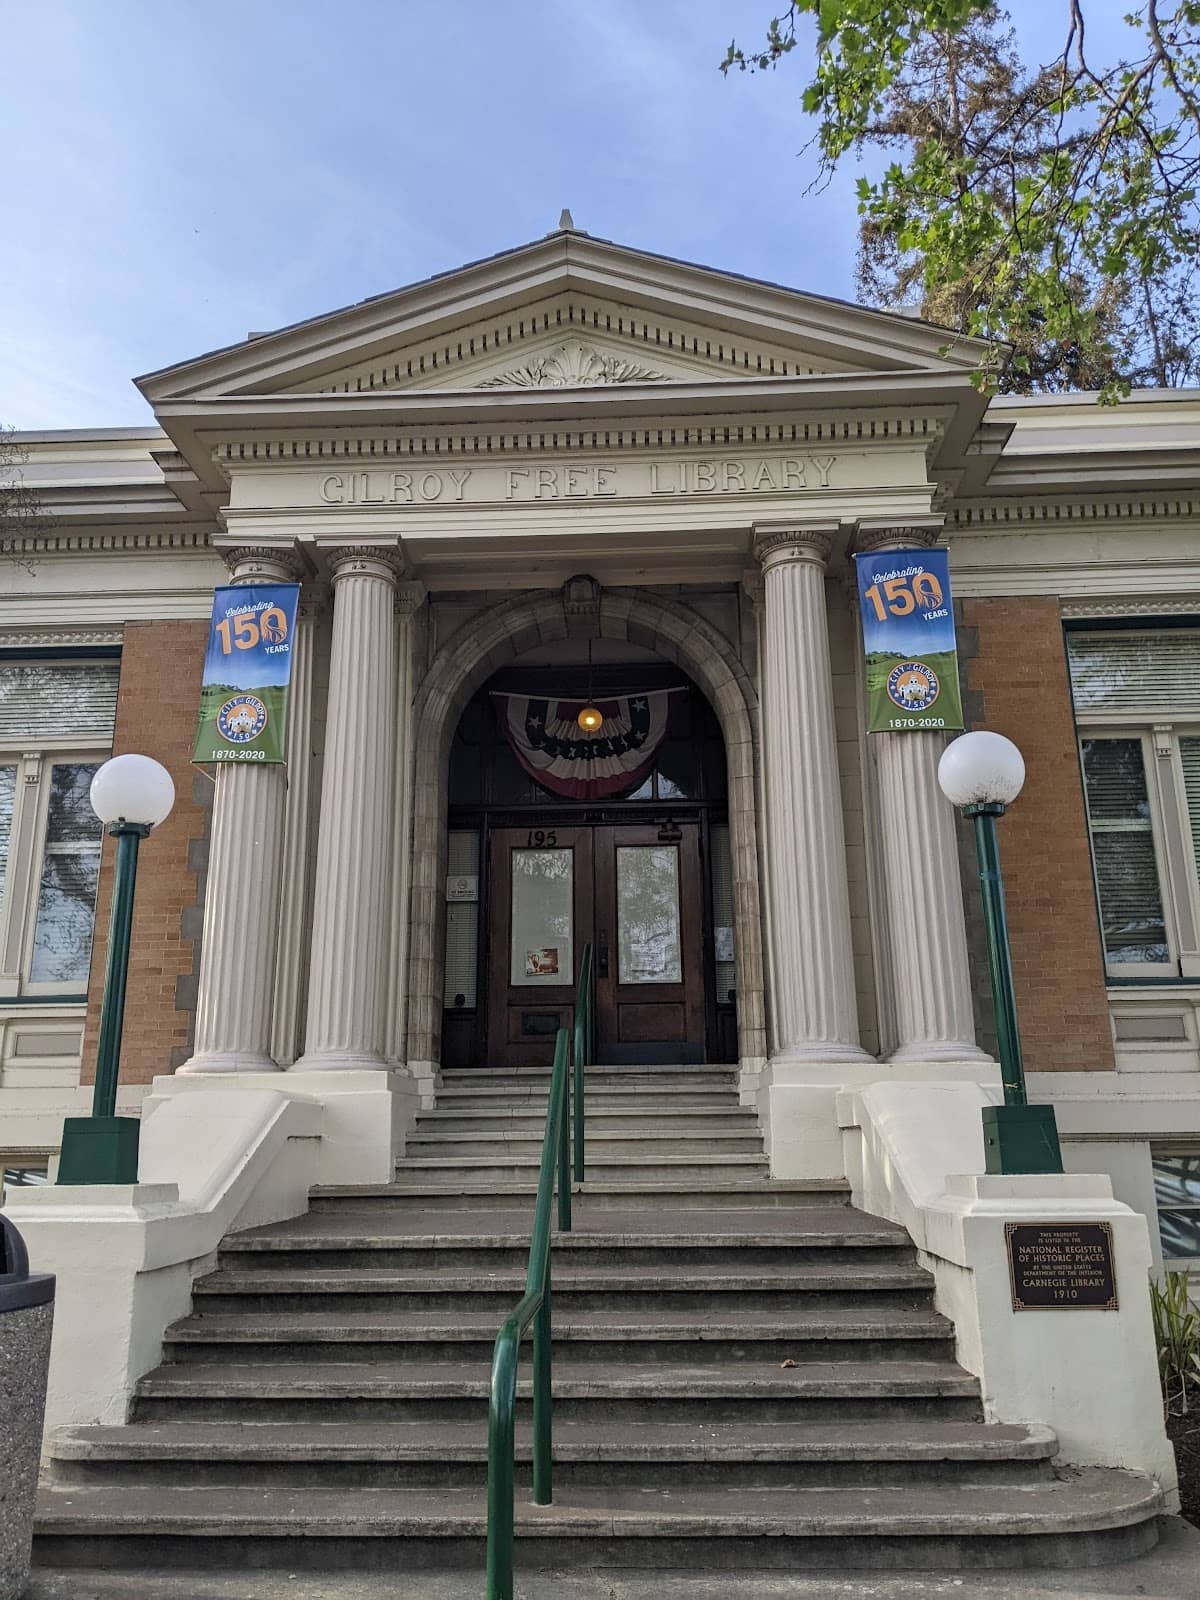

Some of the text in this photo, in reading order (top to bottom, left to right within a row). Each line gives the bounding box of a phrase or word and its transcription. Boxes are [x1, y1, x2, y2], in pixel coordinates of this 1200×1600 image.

[505, 467, 617, 499] FREE
[650, 457, 837, 494] LIBRARY
[872, 565, 925, 584] Celebrating
[865, 572, 943, 622] 150
[225, 600, 275, 618] Celebrating
[923, 608, 949, 621] YEARS
[216, 607, 288, 655] 150
[265, 643, 290, 654] YEARS
[890, 665, 905, 683] CITY
[913, 663, 936, 682] GILROY
[222, 700, 238, 715] CITY
[246, 697, 265, 715] GILROY
[889, 718, 945, 728] 1870-2020
[233, 732, 250, 740] 150
[212, 750, 265, 760] 1870-2020
[528, 830, 557, 847] 195
[1019, 1245, 1103, 1254] NATIONAL REGISTER
[1018, 1253, 1105, 1263] OF HISTORIC PLACES
[1022, 1278, 1105, 1287] CARNEGIE LIBRARY
[1054, 1289, 1078, 1298] 1910
